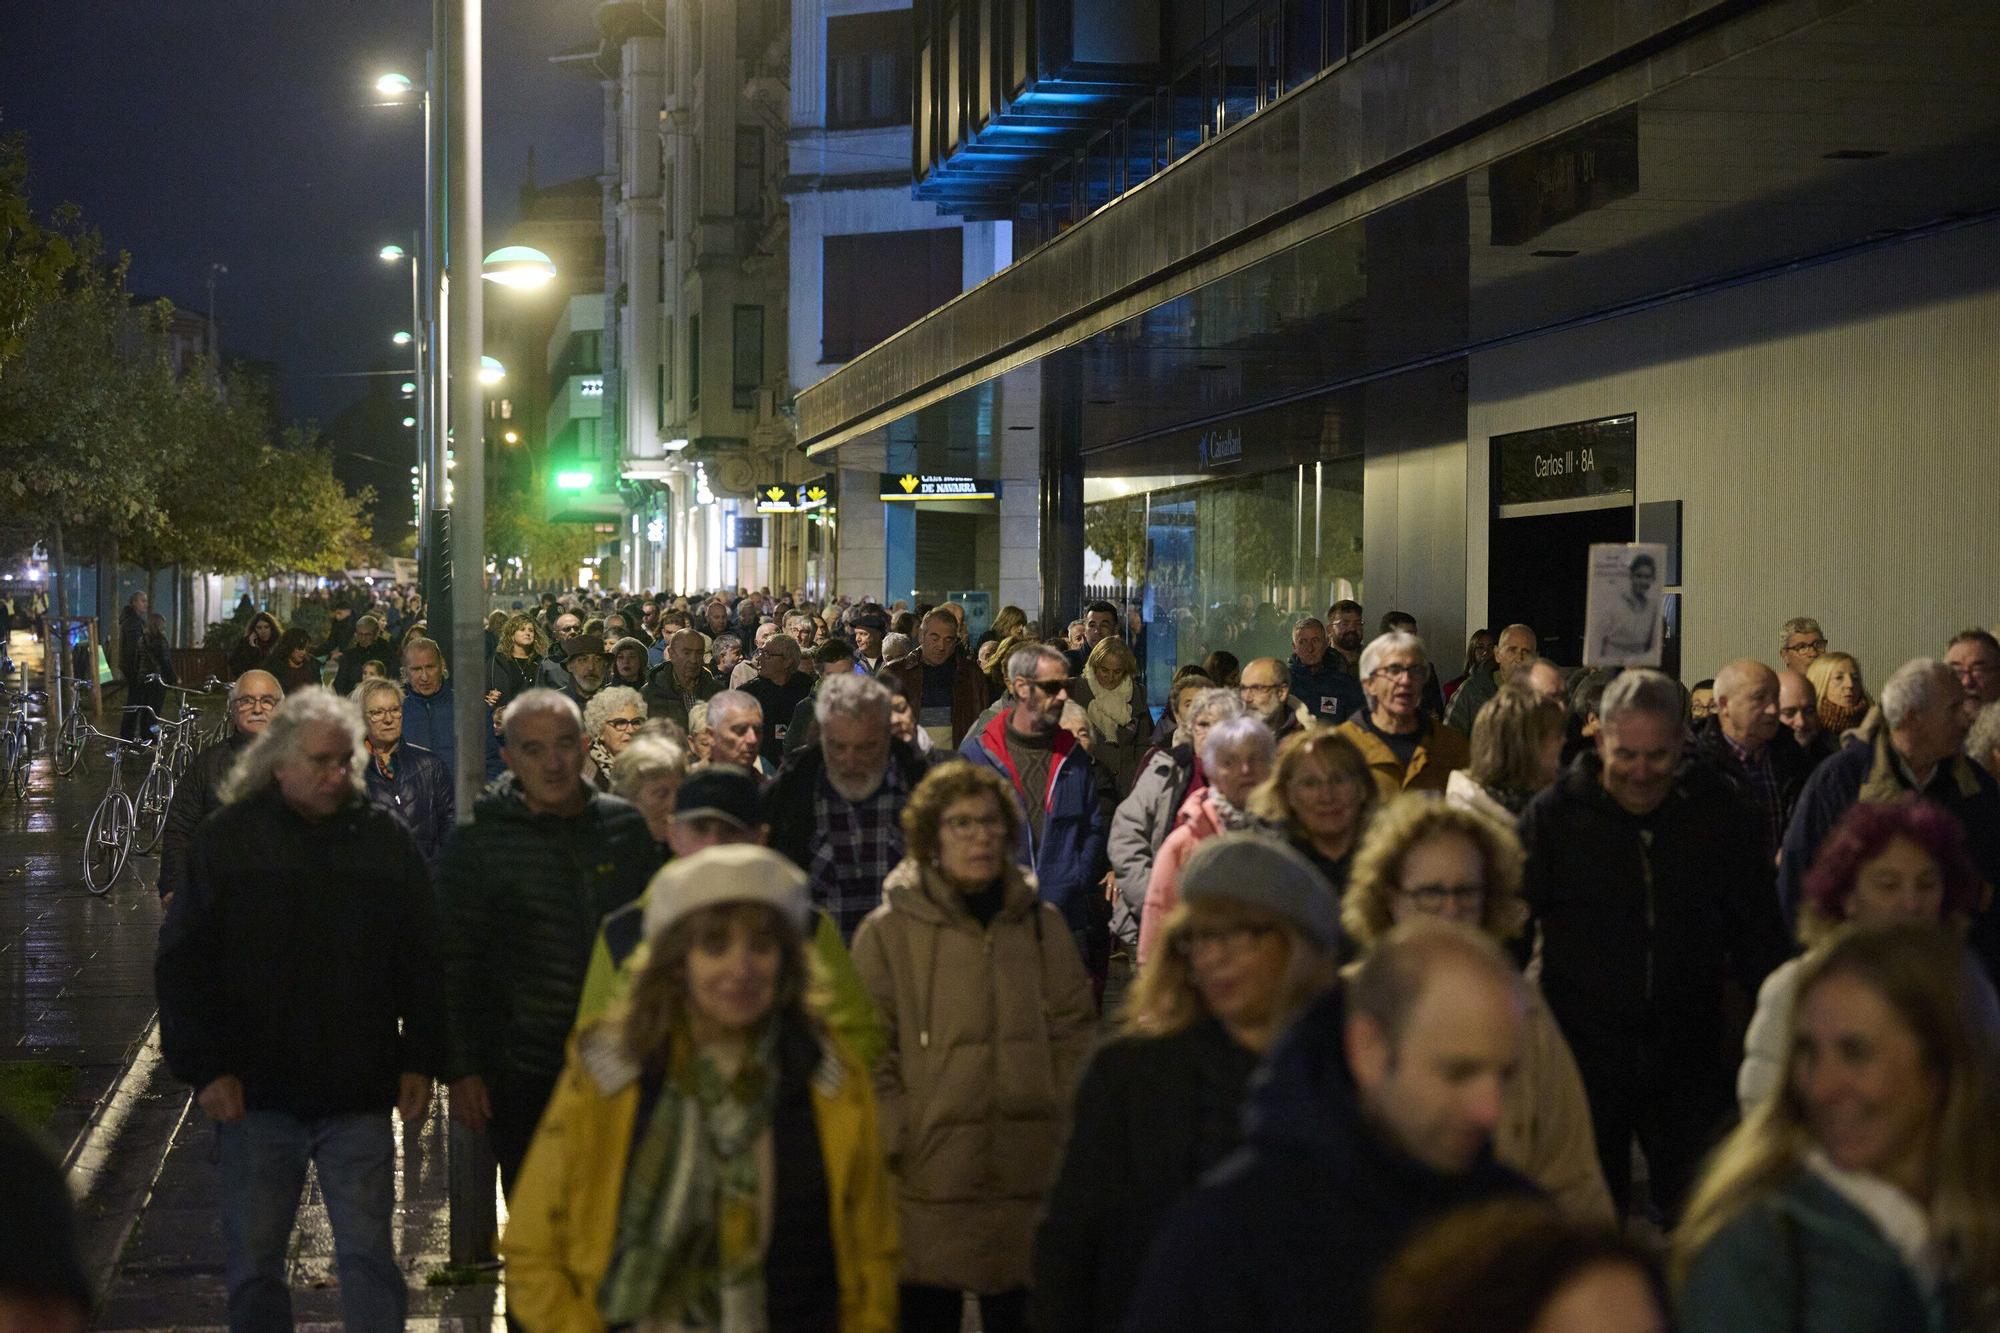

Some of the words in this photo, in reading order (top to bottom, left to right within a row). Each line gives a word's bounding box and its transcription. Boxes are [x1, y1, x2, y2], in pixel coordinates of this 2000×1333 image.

[1535, 453, 1563, 477] Carlos
[1565, 450, 1573, 473] III
[1581, 448, 1595, 472] 8A
[921, 483, 935, 493] DE
[936, 483, 977, 493] NAVARRA
